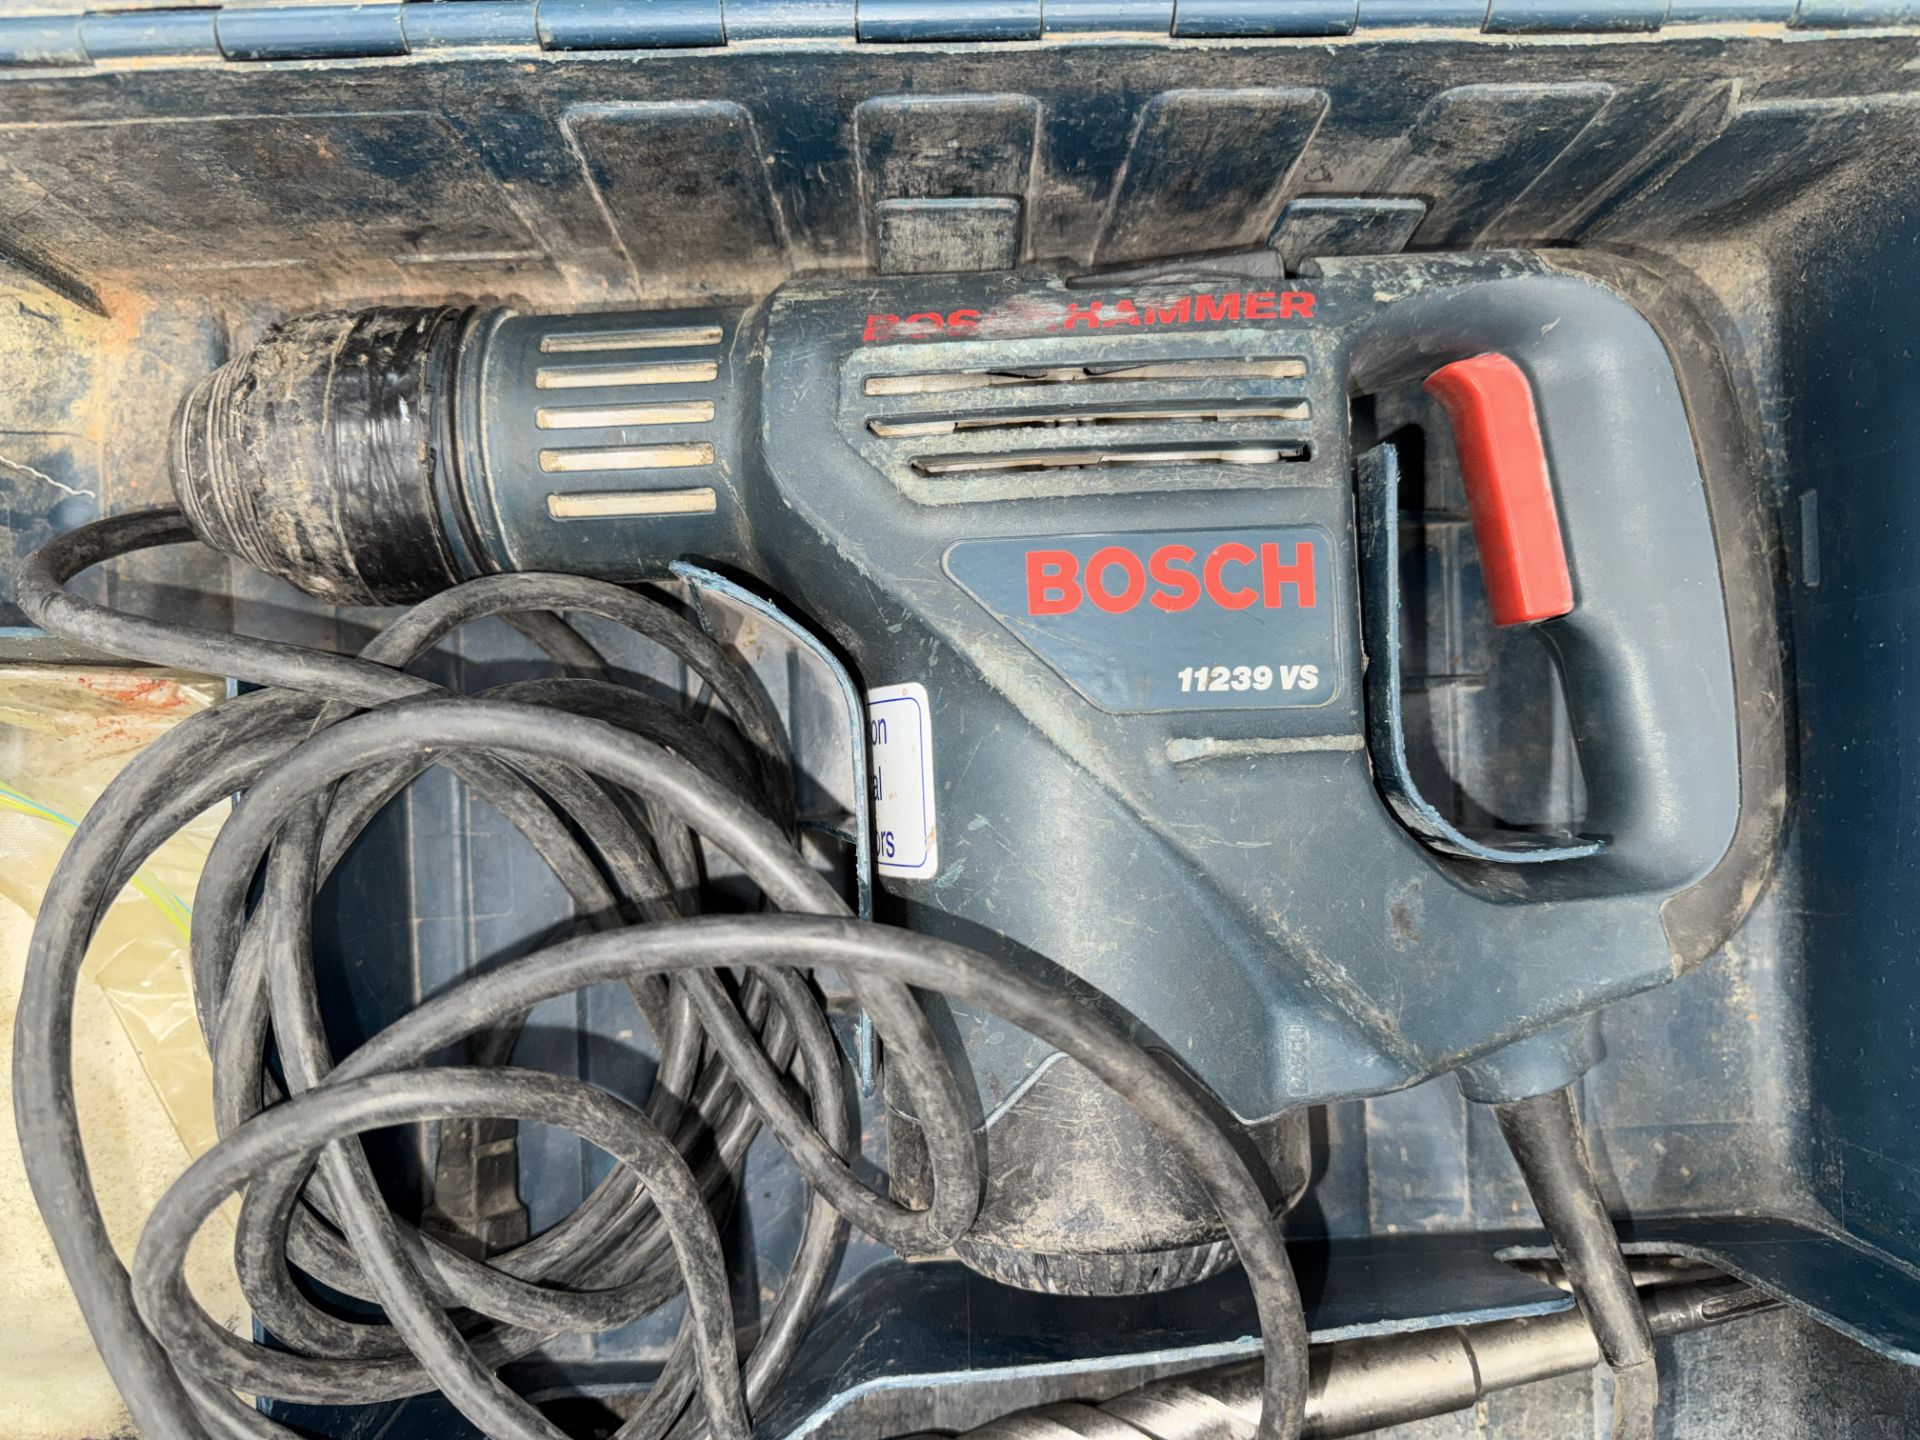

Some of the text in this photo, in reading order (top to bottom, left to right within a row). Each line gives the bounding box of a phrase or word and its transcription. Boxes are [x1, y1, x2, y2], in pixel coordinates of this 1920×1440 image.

[1025, 541, 1316, 616] BOSCH
[1178, 664, 1319, 693] 11239 VS
